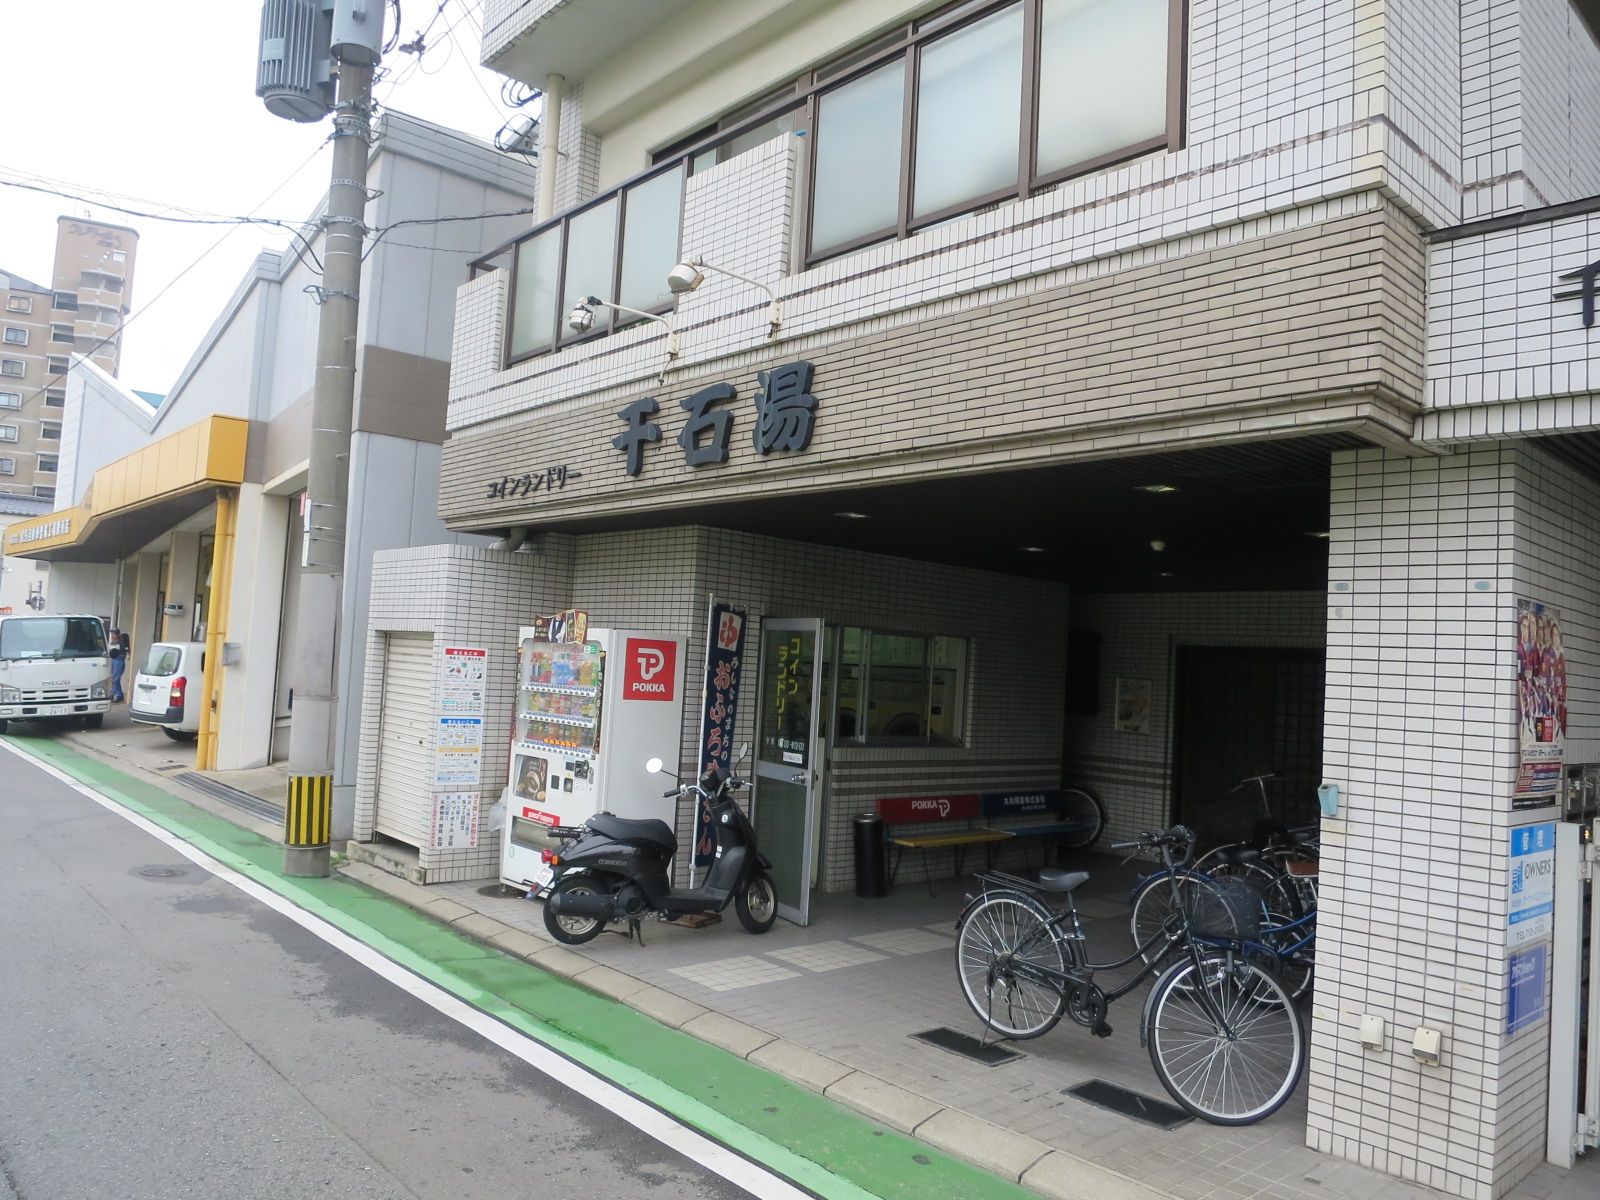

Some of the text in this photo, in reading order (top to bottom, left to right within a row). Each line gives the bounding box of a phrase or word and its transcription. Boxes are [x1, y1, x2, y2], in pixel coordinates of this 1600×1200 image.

[612, 359, 819, 478] 千石湯
[486, 464, 582, 500] コインランドリー
[719, 614, 739, 648] ゆ
[788, 638, 800, 695] コイン
[632, 682, 665, 693] POKKA
[776, 646, 789, 730] ランドリー
[912, 800, 937, 810] POKKA
[1525, 859, 1551, 879] OWNERS
